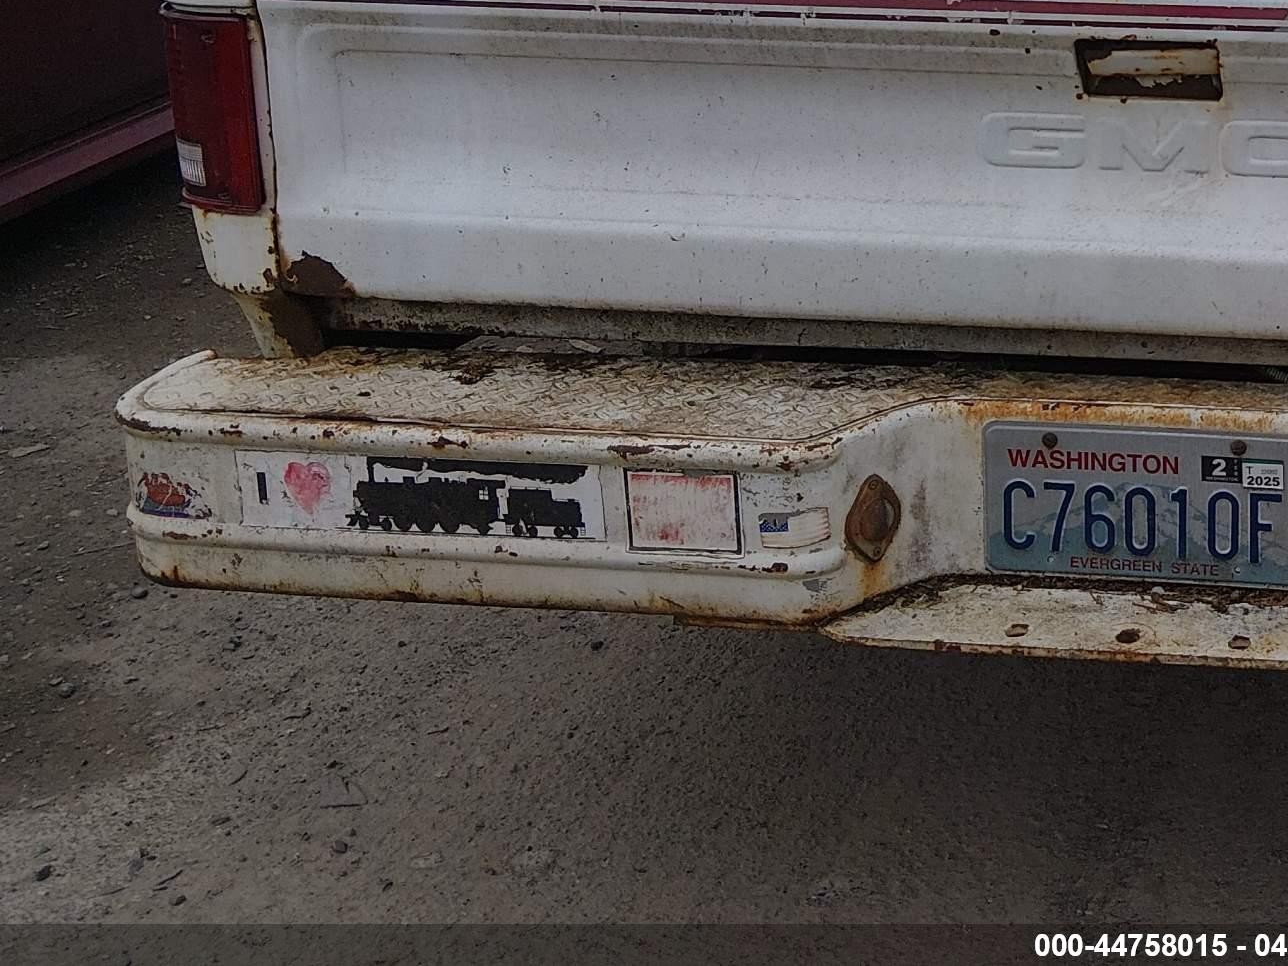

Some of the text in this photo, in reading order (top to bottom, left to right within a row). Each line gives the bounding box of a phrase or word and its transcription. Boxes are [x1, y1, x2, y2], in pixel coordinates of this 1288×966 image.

[1007, 448, 1180, 475] WASHINGTON
[1212, 458, 1227, 476] 2
[1245, 466, 1254, 475] T
[1246, 475, 1280, 487] 2025
[1002, 479, 1283, 565] C76010F
[1070, 555, 1219, 576] EVERGREEN STATE
